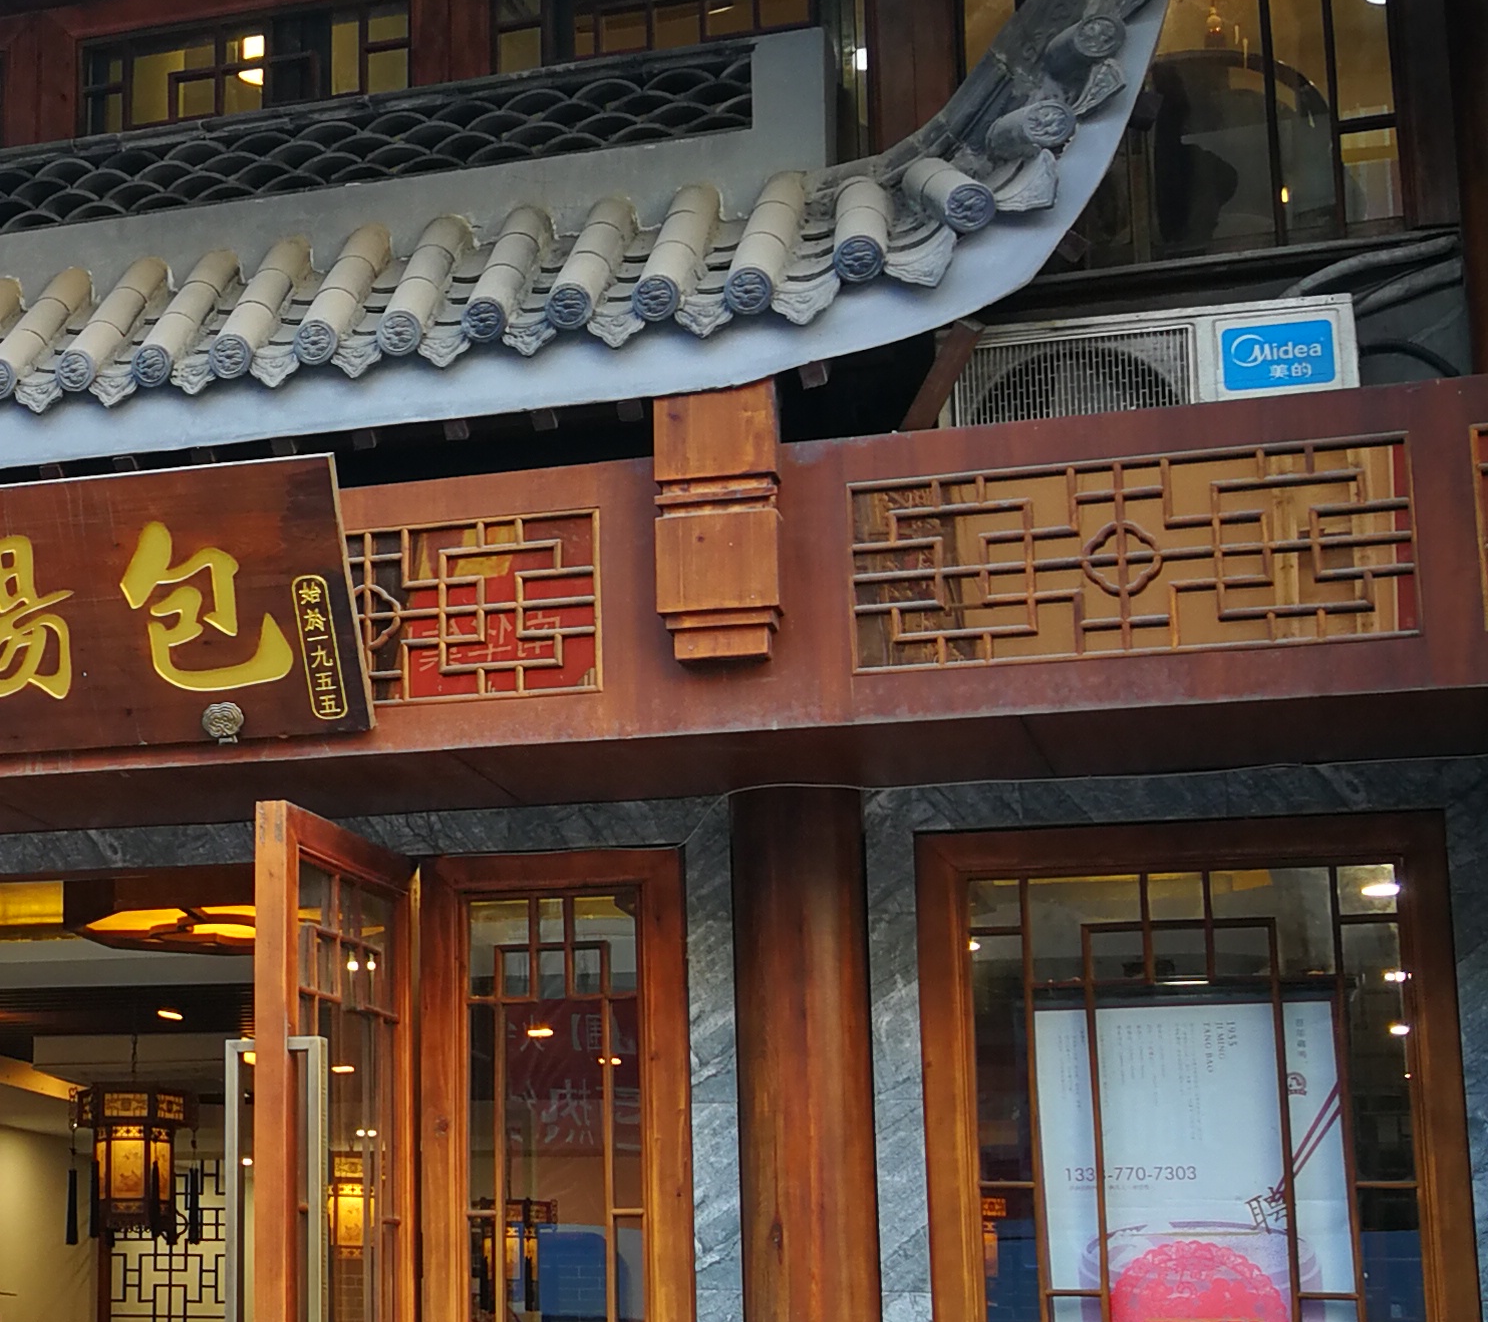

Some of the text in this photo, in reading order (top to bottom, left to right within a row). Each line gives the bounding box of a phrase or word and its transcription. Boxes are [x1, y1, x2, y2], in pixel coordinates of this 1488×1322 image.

[1239, 337, 1323, 365] Midea
[1268, 363, 1312, 380] 美的
[298, 581, 341, 714] 始於一九五五
[1065, 1165, 1198, 1182] 133-770-7303
